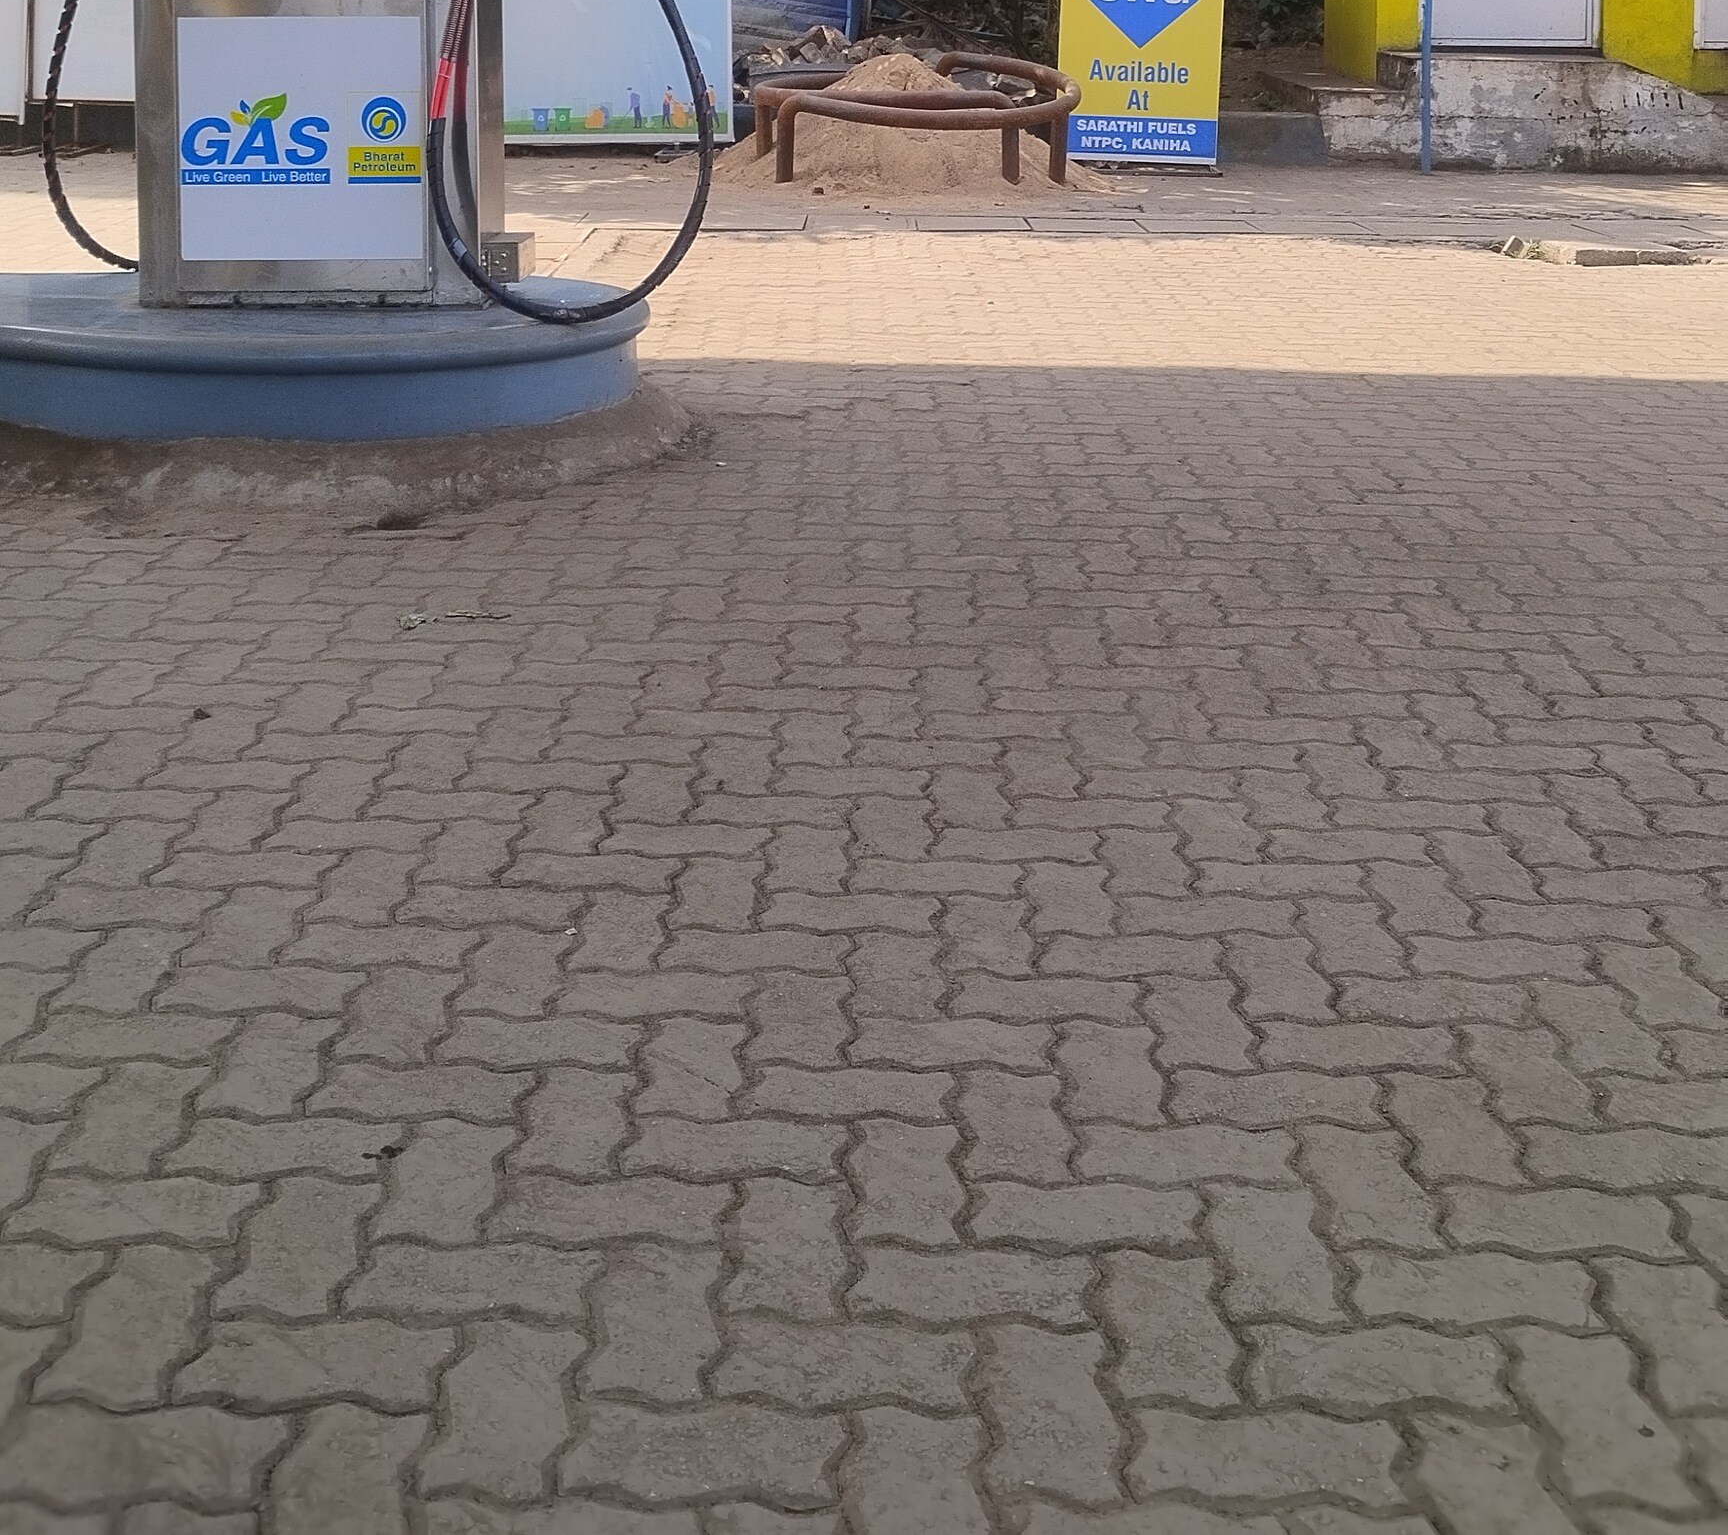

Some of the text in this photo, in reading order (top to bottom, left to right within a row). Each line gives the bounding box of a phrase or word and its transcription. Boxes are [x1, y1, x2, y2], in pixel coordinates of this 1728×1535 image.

[1089, 59, 1189, 84] Available
[1126, 89, 1149, 111] At
[1076, 118, 1197, 135] SARATHI FUELS
[180, 116, 331, 166] GAS
[1080, 136, 1191, 151] NTPC, KANIHA
[363, 151, 405, 162] Bharat
[353, 162, 416, 172] Petroleum
[185, 170, 327, 183] Live Green Live Better
